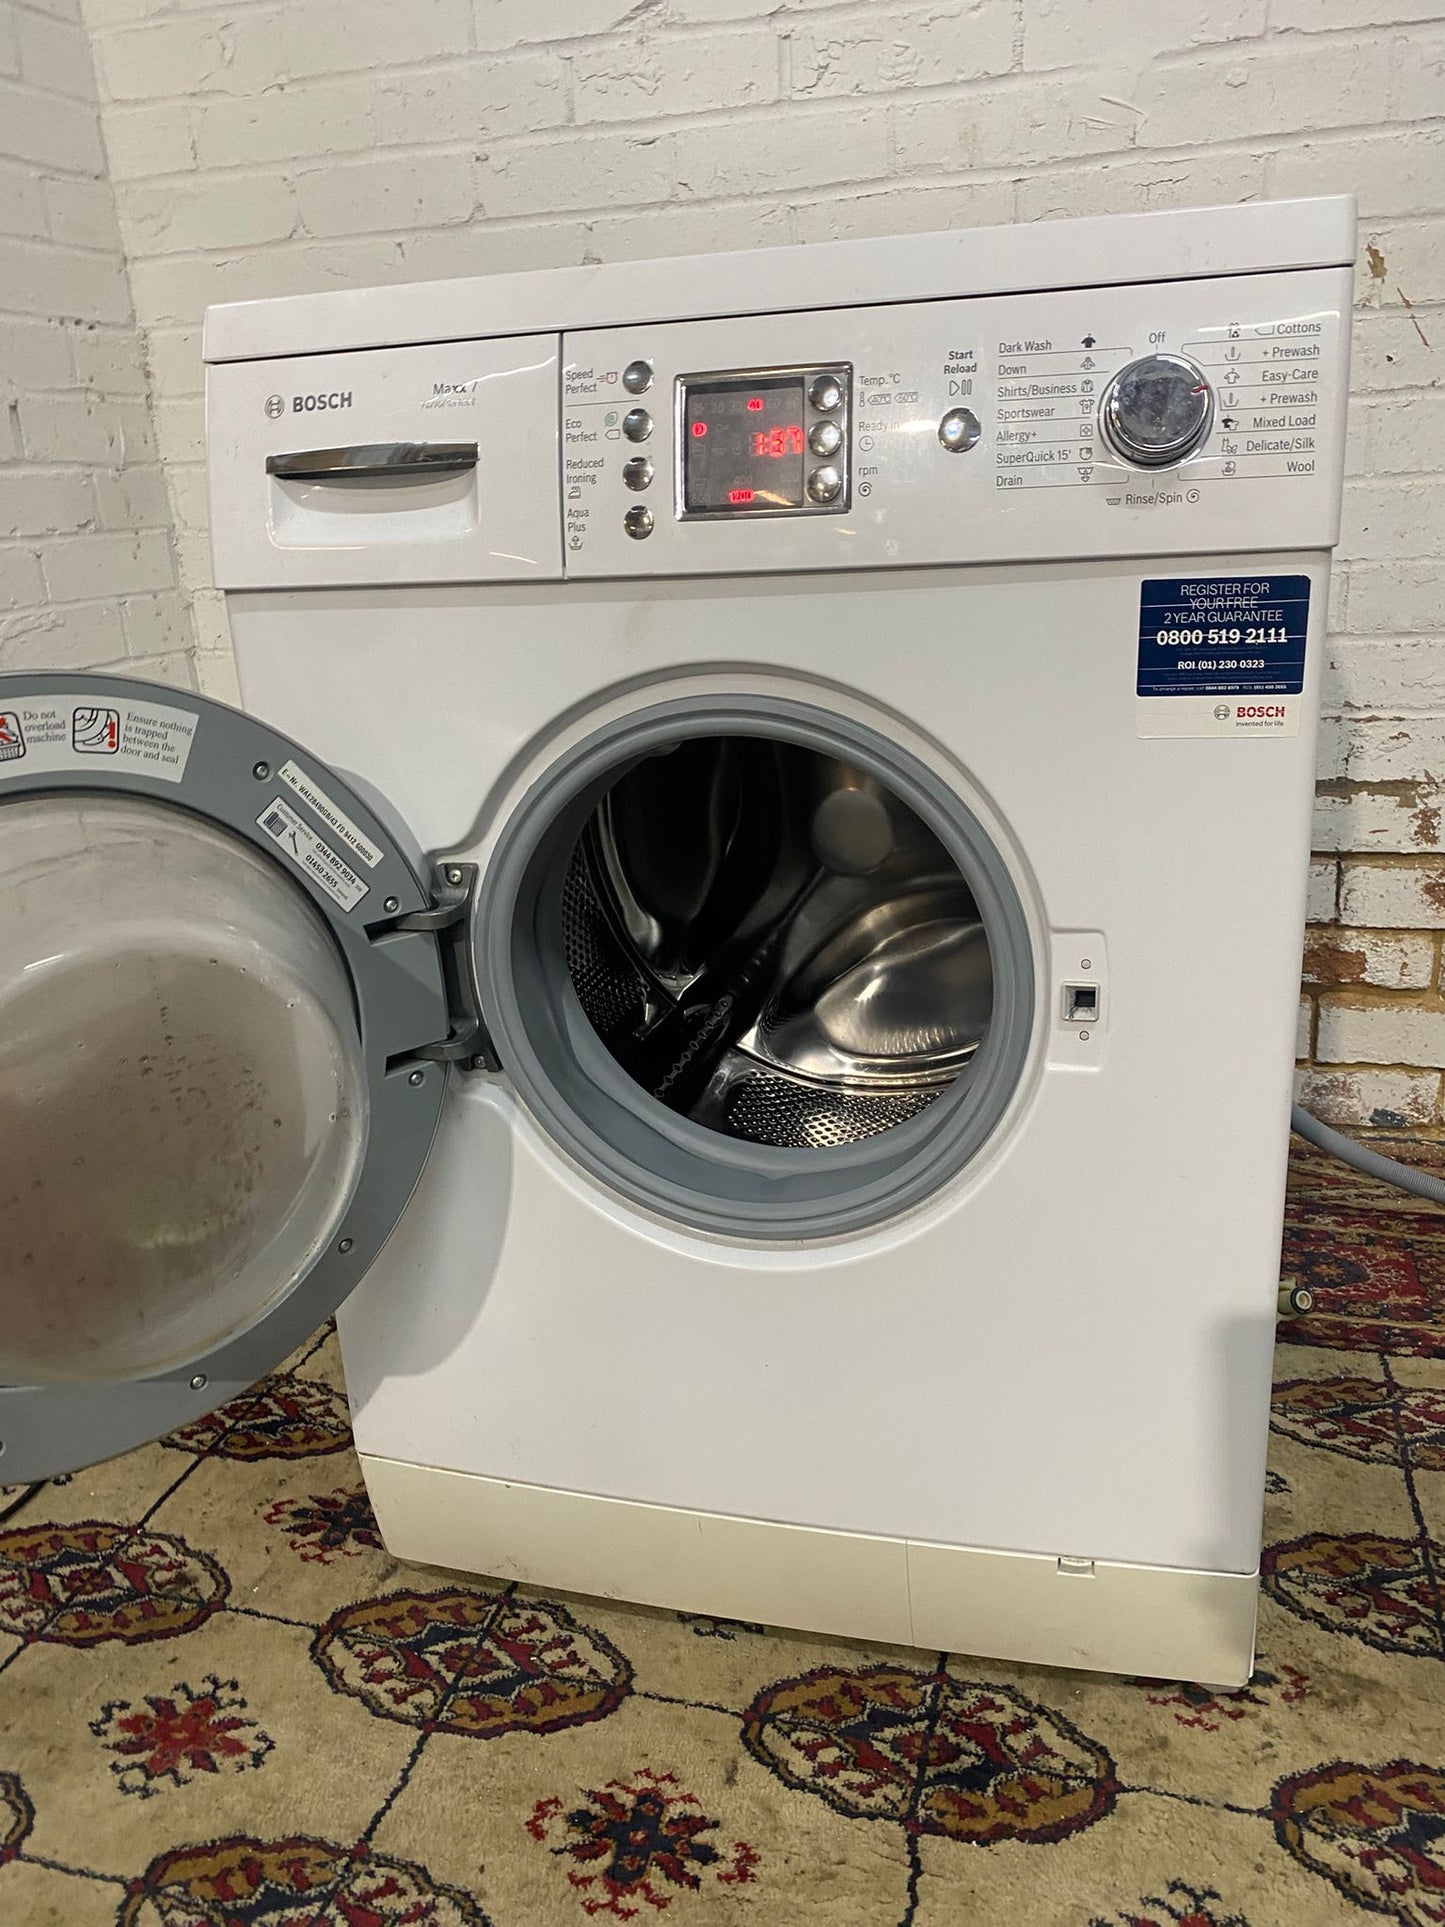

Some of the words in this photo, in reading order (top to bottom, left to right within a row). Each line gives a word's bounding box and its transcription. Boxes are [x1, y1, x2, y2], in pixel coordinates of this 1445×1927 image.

[1277, 323, 1322, 334] Cottons
[1148, 332, 1166, 344] Off
[999, 342, 1022, 354] Dark
[1025, 340, 1052, 351] Wash
[1272, 344, 1320, 358] Prewash
[948, 350, 973, 360] Start
[944, 362, 977, 374] Reload
[998, 364, 1026, 376] Down
[566, 368, 594, 382] Speed
[566, 384, 596, 394] Perfect
[998, 384, 1076, 398] Shirts/Business
[292, 392, 352, 412] BOSCH
[1270, 391, 1318, 404] Prewash
[998, 407, 1055, 420] Sportswear
[566, 419, 582, 429] Eco
[1253, 416, 1286, 428] Mixed
[1288, 414, 1316, 426] Load
[859, 422, 888, 433] Ready
[566, 432, 597, 443] Perfect
[1246, 438, 1316, 452] Delicate/Silk
[996, 451, 1054, 464] SuperQuick
[566, 458, 604, 470] Reduced
[1286, 460, 1314, 472] Wool
[858, 466, 878, 477] rpm
[566, 473, 596, 484] Ironing
[996, 475, 1022, 486] Drain
[1126, 492, 1182, 506] Rinse/Spin
[567, 508, 589, 520] Aqua
[568, 522, 586, 532] Plus
[1180, 584, 1241, 596] REGISTER
[1244, 582, 1270, 594] FOR
[1190, 598, 1224, 610] YOUR
[1226, 596, 1258, 608] FREE
[1164, 612, 1171, 624] 2
[1173, 612, 1205, 624] YEAR
[1208, 610, 1283, 622] GUARANTEE
[1156, 630, 1203, 646] 0800
[1208, 628, 1240, 644] 519
[1245, 628, 1288, 644] 2111
[1178, 661, 1195, 670] ROI
[1198, 660, 1216, 670] (01)
[1218, 660, 1237, 669] 230
[1240, 660, 1264, 668] 0323
[23, 711, 38, 720] Do
[40, 710, 56, 719] not
[1237, 706, 1285, 718] BOSCH
[24, 720, 66, 732] overload
[127, 712, 158, 727] Ensure
[159, 720, 192, 736] nothing
[26, 732, 66, 744] machine
[135, 726, 168, 740] trapped
[122, 734, 159, 750] between
[161, 742, 176, 752] the
[120, 744, 142, 758] door
[143, 750, 160, 761] and
[162, 753, 180, 764] seal
[328, 856, 343, 870] 892
[321, 870, 338, 888] 2655
